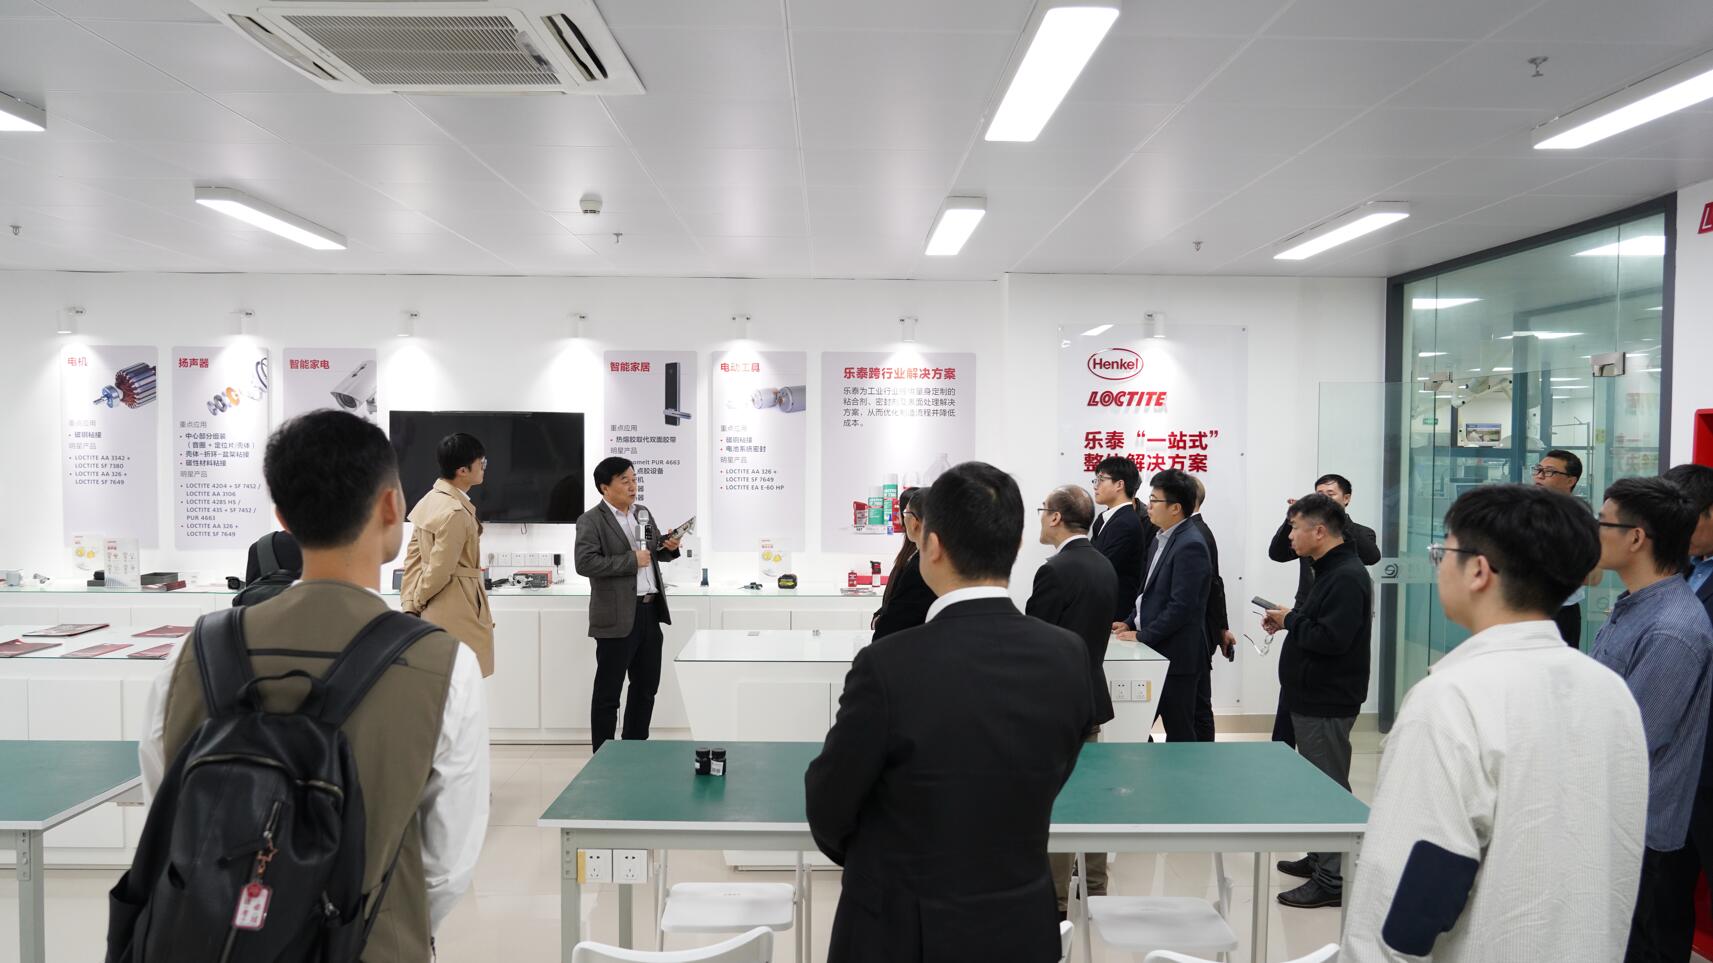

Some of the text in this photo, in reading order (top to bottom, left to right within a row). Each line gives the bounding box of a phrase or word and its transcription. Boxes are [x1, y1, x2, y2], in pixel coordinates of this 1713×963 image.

[67, 357, 88, 366] 电机
[178, 358, 209, 368] 扬声器
[290, 360, 329, 369] 智能家电
[1093, 358, 1138, 370] Henkel
[610, 362, 650, 372] 智能家居
[720, 363, 760, 372] 电动工具
[844, 367, 956, 380] 乐泰跨行业解决方案
[1087, 391, 1167, 406] LOCTITE
[1083, 453, 1208, 473] 整解决方案
